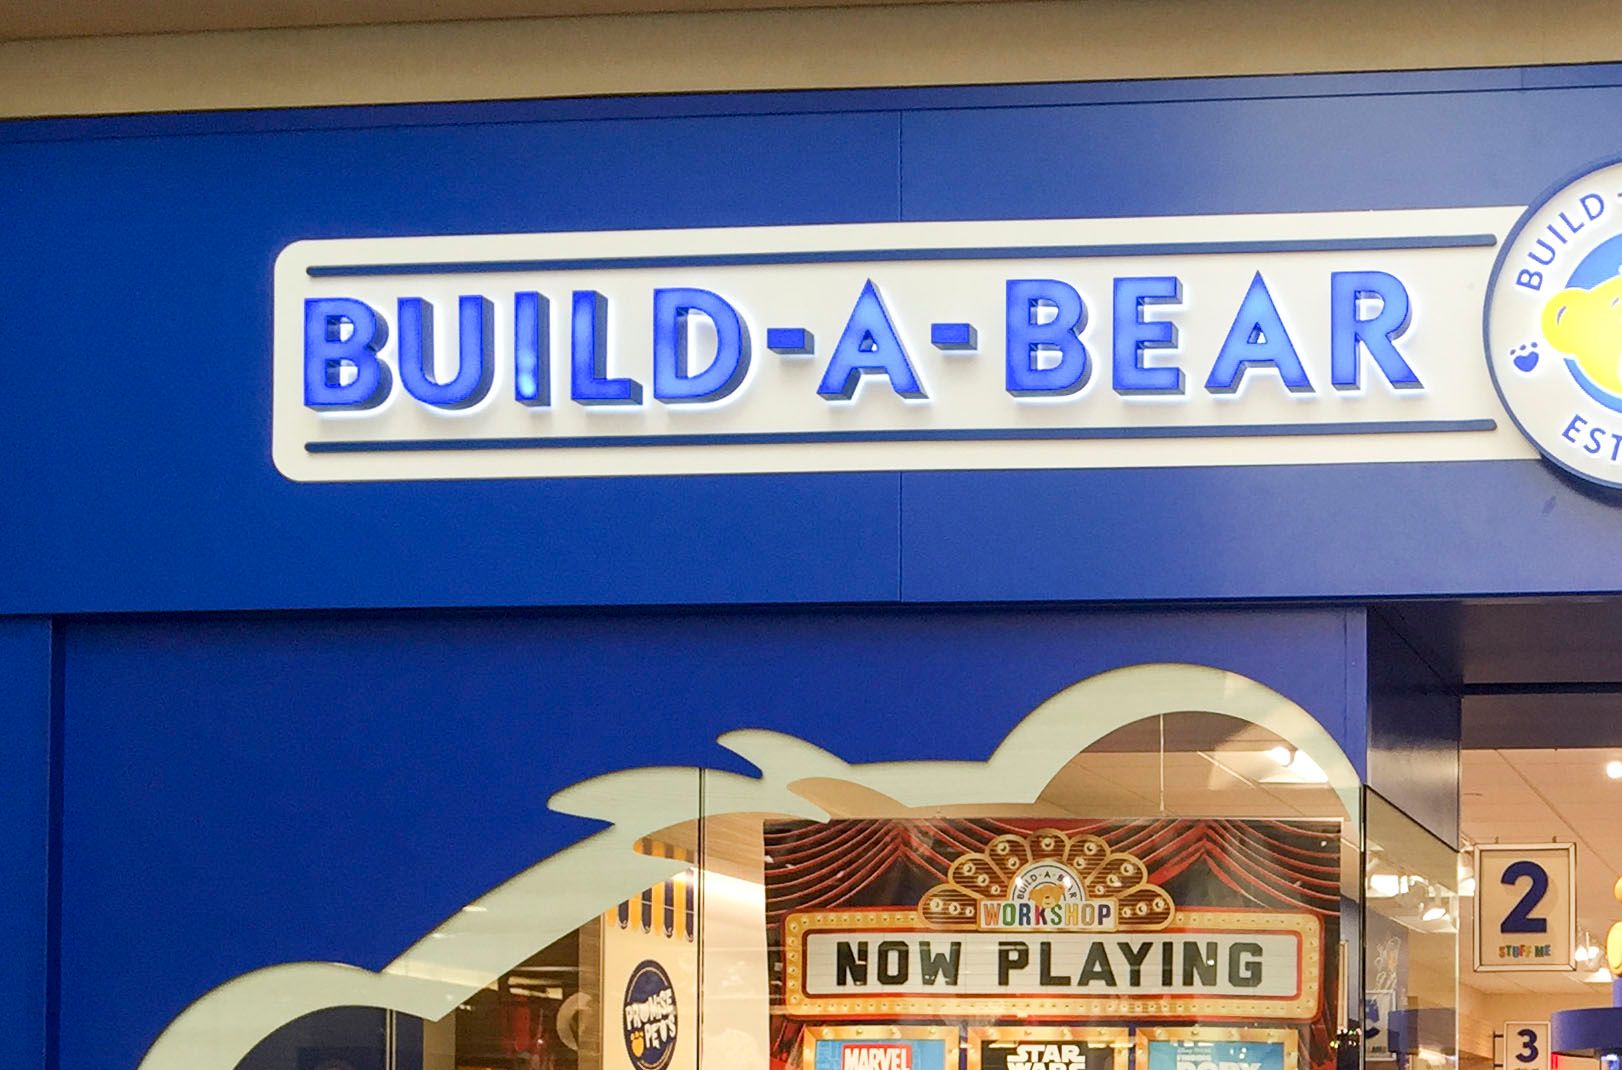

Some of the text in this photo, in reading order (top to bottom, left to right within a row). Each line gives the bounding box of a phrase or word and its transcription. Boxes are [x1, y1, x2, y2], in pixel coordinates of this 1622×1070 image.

[303, 269, 1424, 411] BUILD-A-BEAR
[1016, 870, 1078, 900] BUILD-A-BR
[1500, 860, 1549, 934] 2
[983, 902, 1112, 927] WORKSHOP
[836, 940, 1264, 988] NOW PLAYING
[1498, 944, 1551, 958] STUFF ME
[625, 988, 674, 1031] PROMISE
[644, 1013, 676, 1050] PETS
[1515, 1028, 1539, 1064] 3
[1006, 1044, 1086, 1063] STAR
